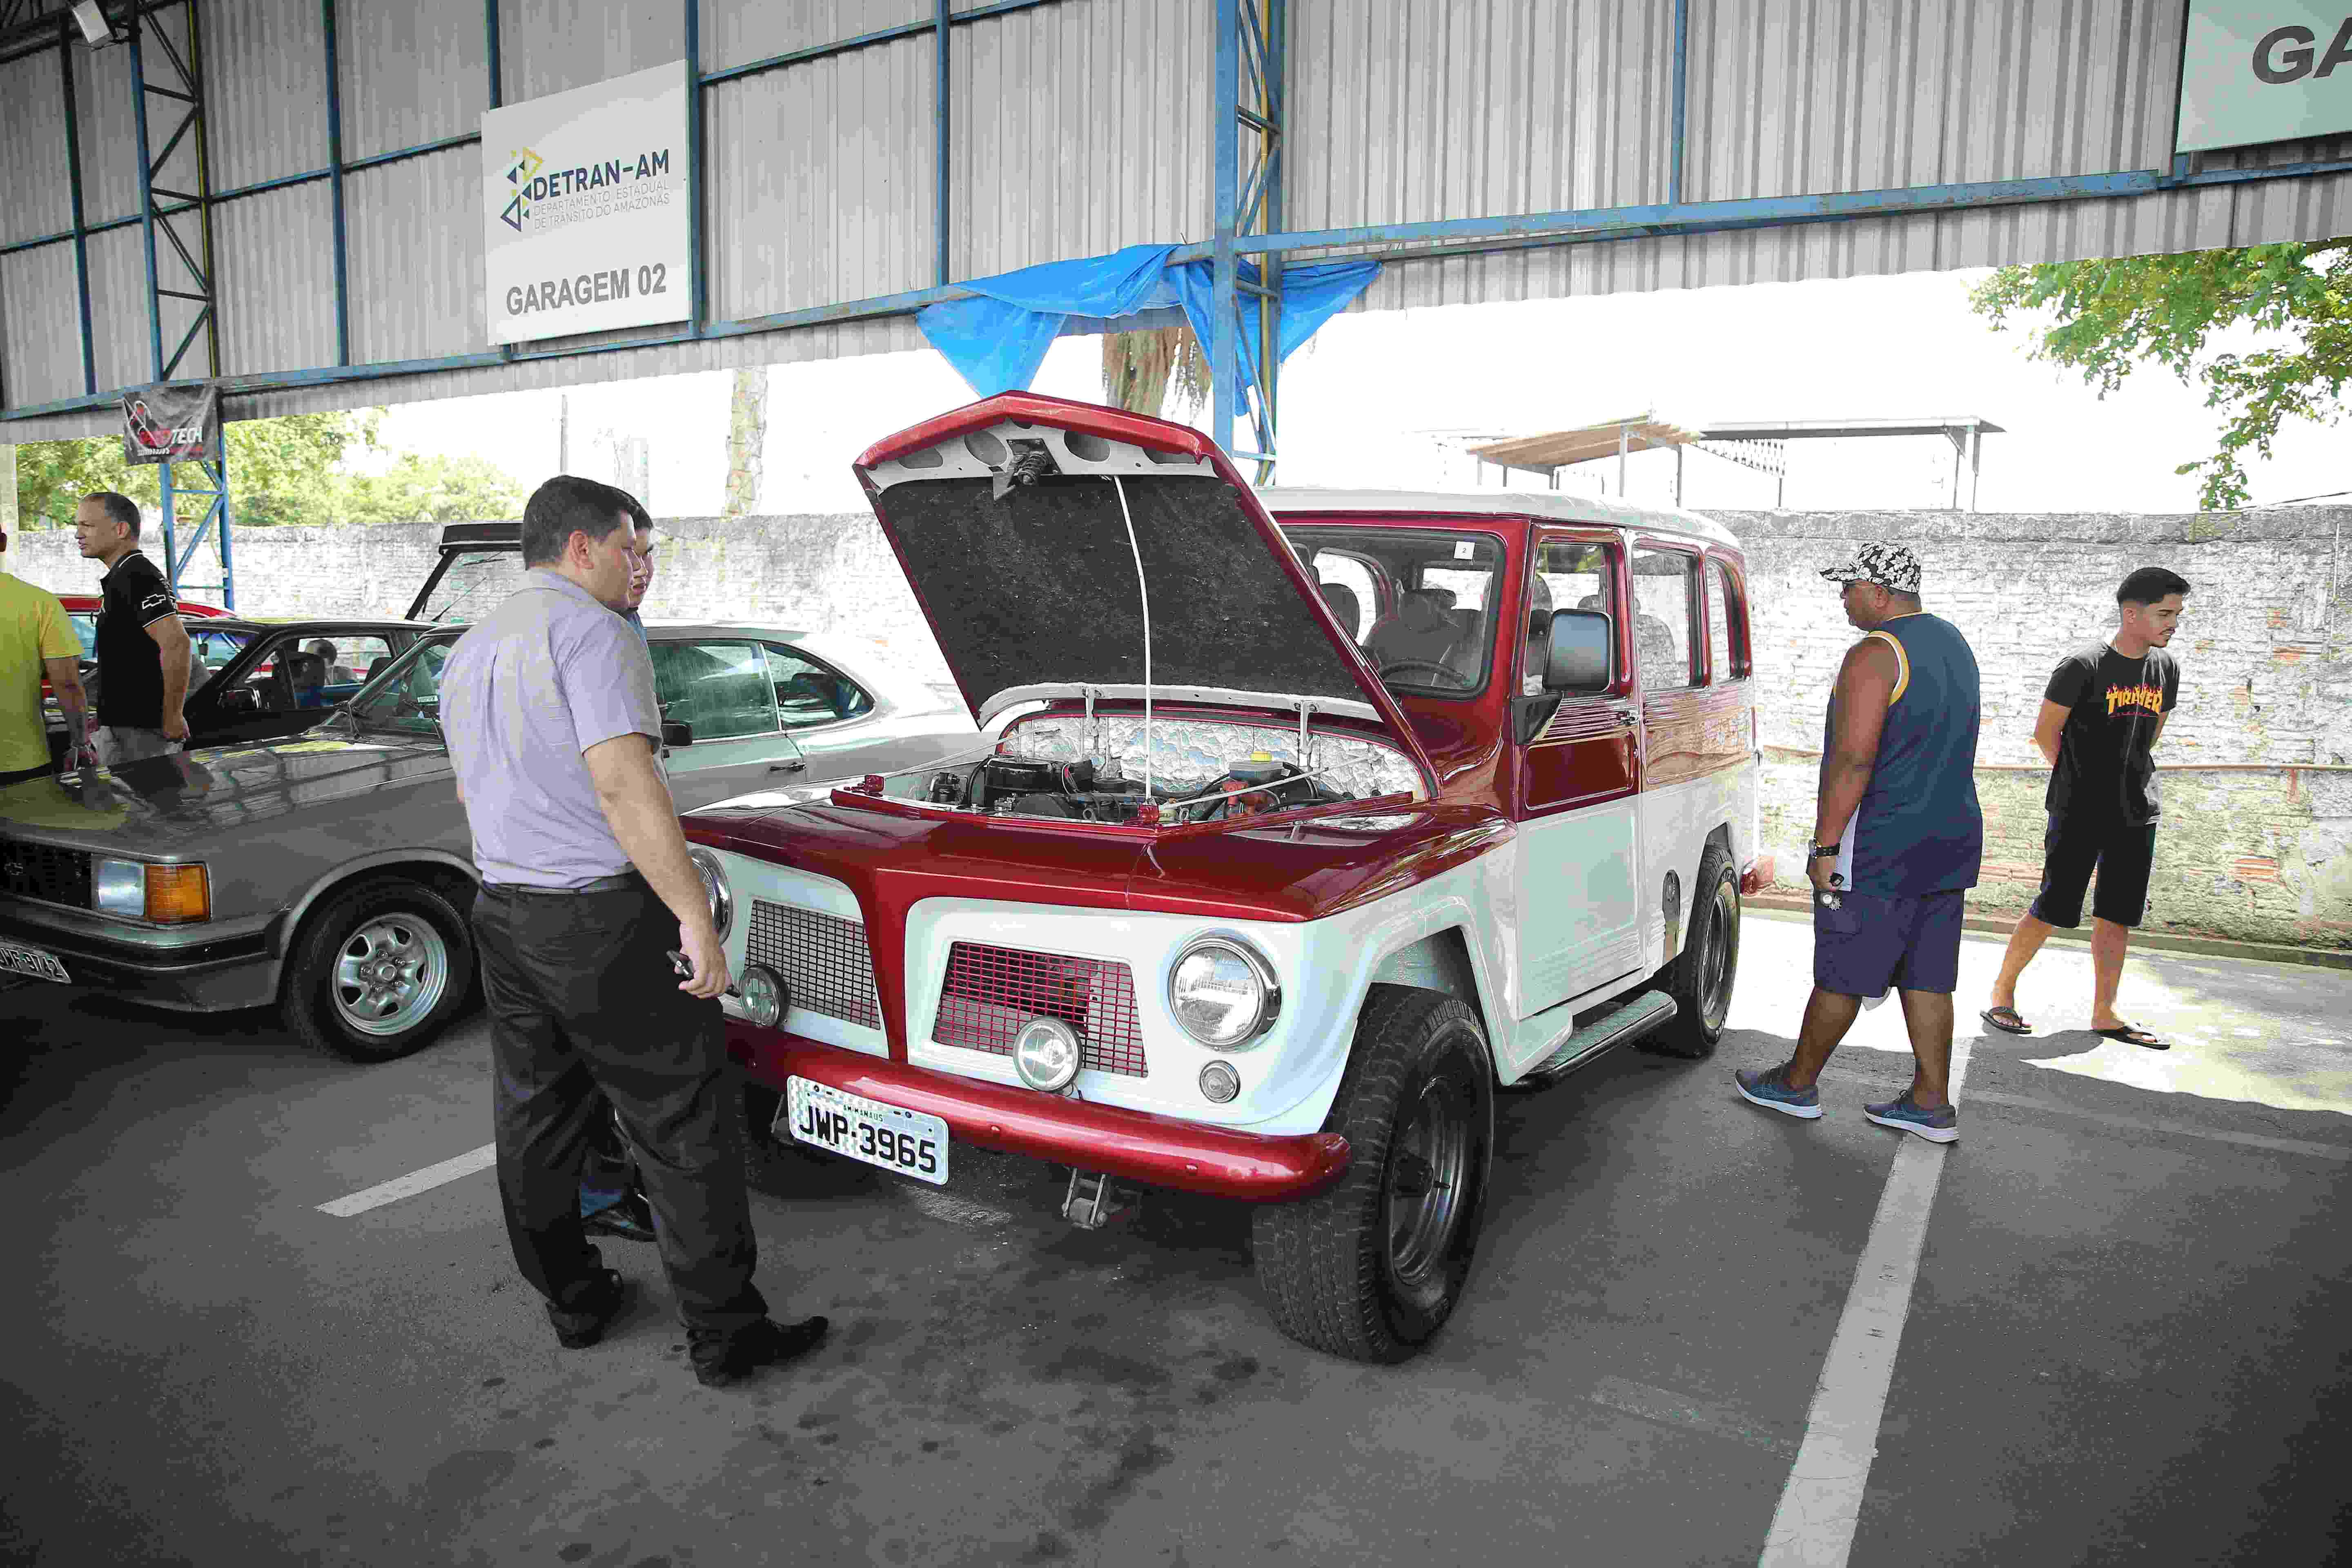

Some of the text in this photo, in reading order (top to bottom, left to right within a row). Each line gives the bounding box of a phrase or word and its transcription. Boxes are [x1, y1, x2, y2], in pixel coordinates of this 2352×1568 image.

[533, 149, 669, 201] DETRAN-AM
[534, 180, 670, 216] DEPARTAMENTO ESTADUAL
[534, 217, 546, 229] DE
[595, 204, 611, 218] DO
[614, 193, 670, 213] AMAZONAS
[506, 263, 666, 315] GARAGEM 02
